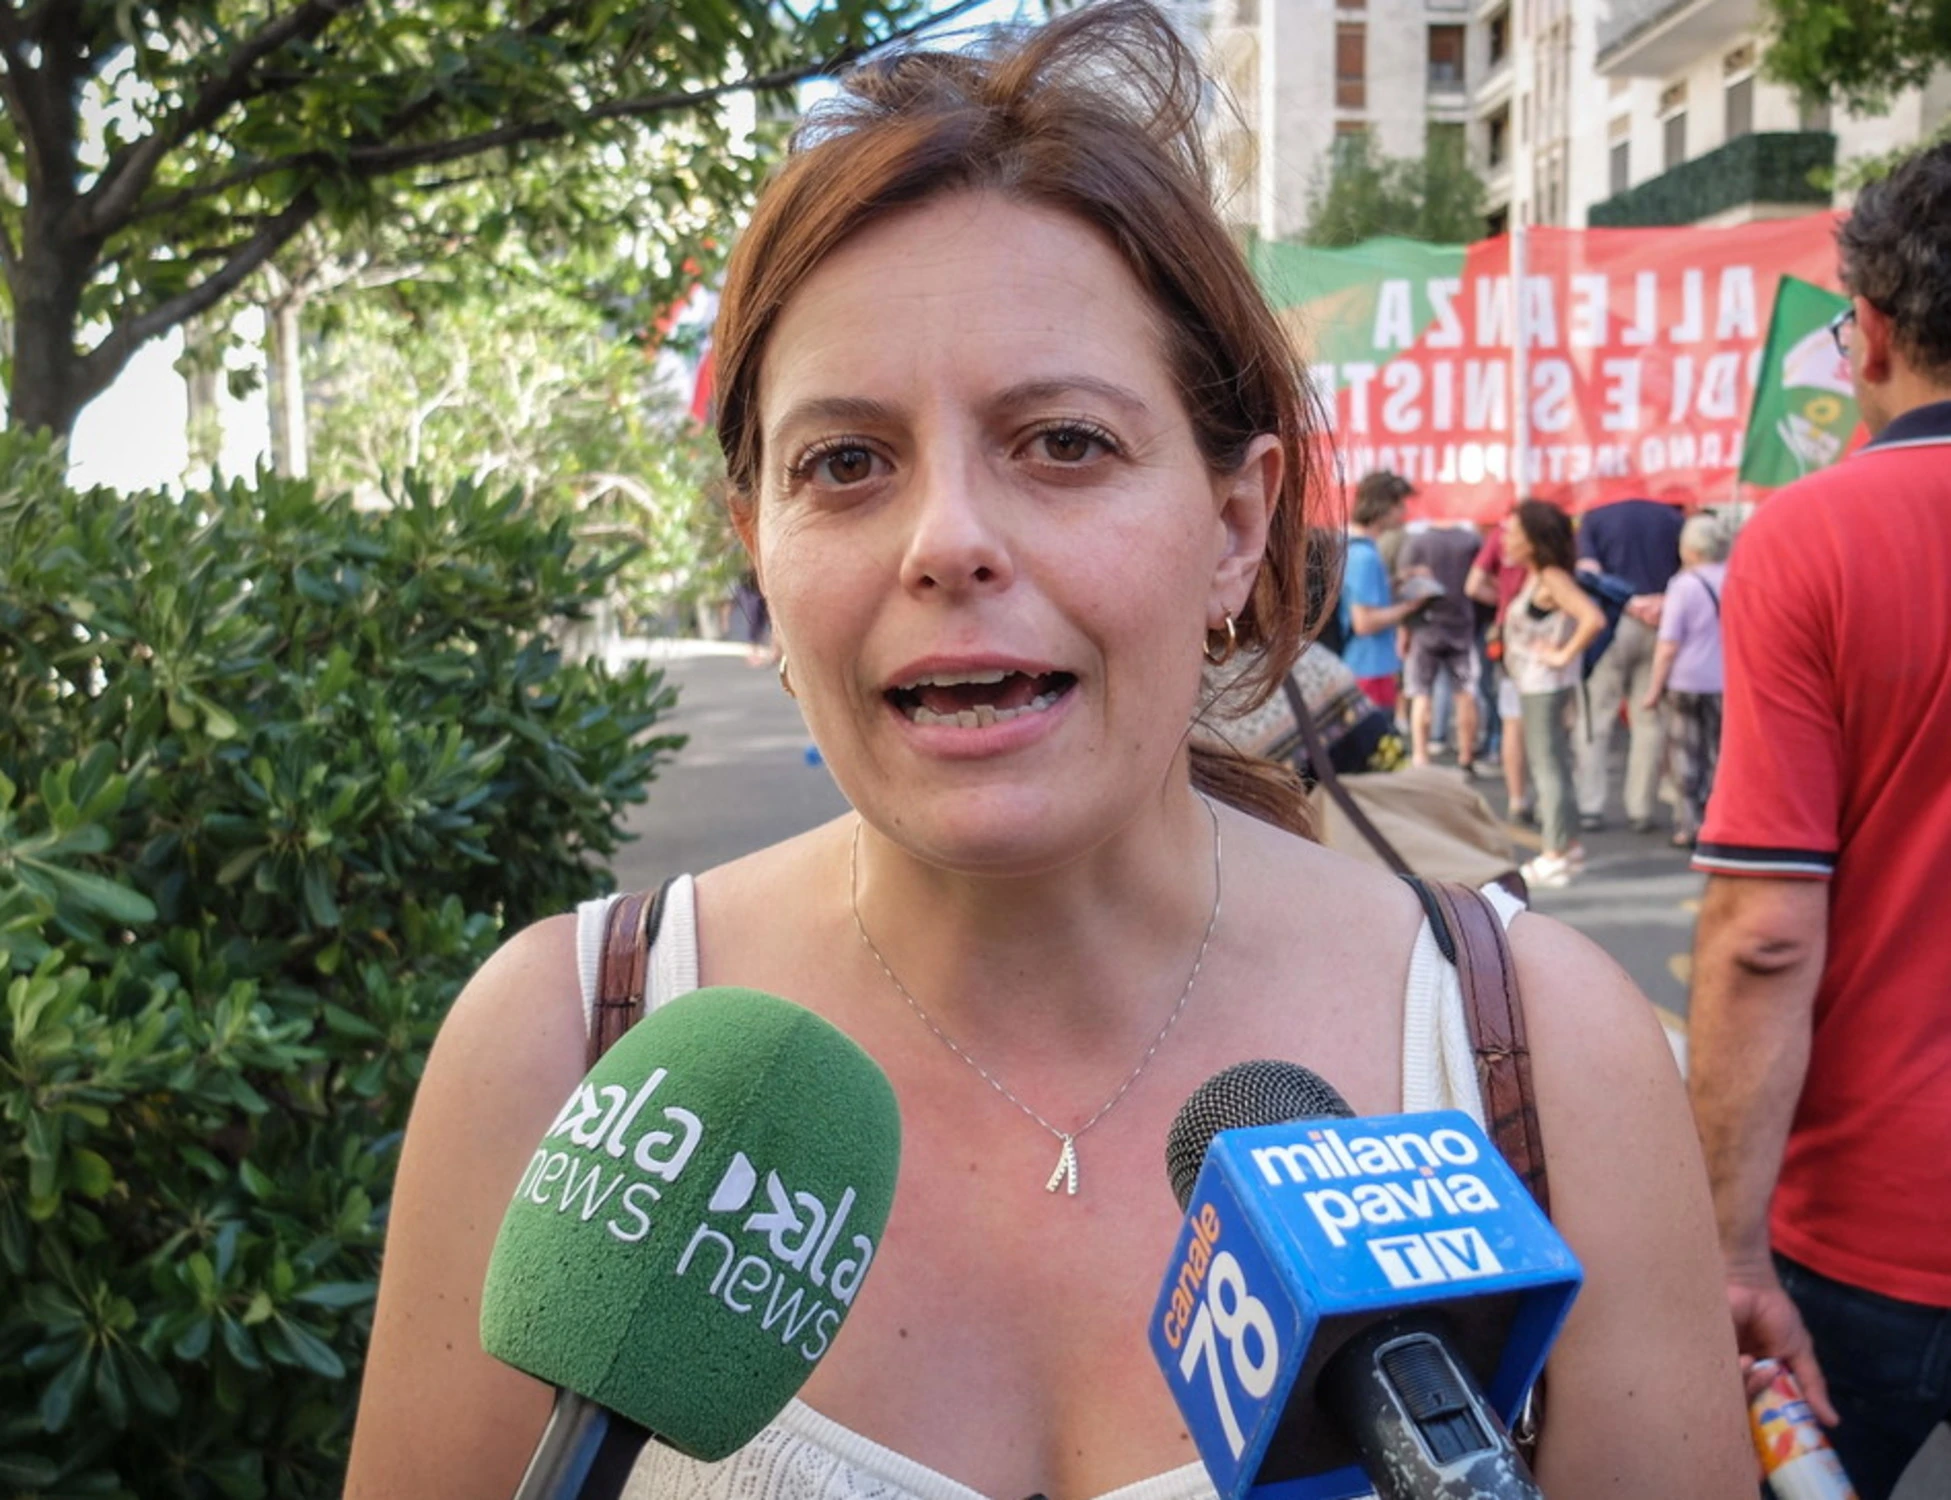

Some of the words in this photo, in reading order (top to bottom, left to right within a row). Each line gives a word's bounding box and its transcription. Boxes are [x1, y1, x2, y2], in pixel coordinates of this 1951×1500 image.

[519, 1148, 662, 1241] news
[1251, 1128, 1480, 1187] milano
[1304, 1166, 1499, 1247] pavia
[676, 1222, 840, 1362] news
[1163, 1202, 1221, 1349] canale
[1375, 1230, 1492, 1286] TV
[1179, 1251, 1280, 1461] 78
